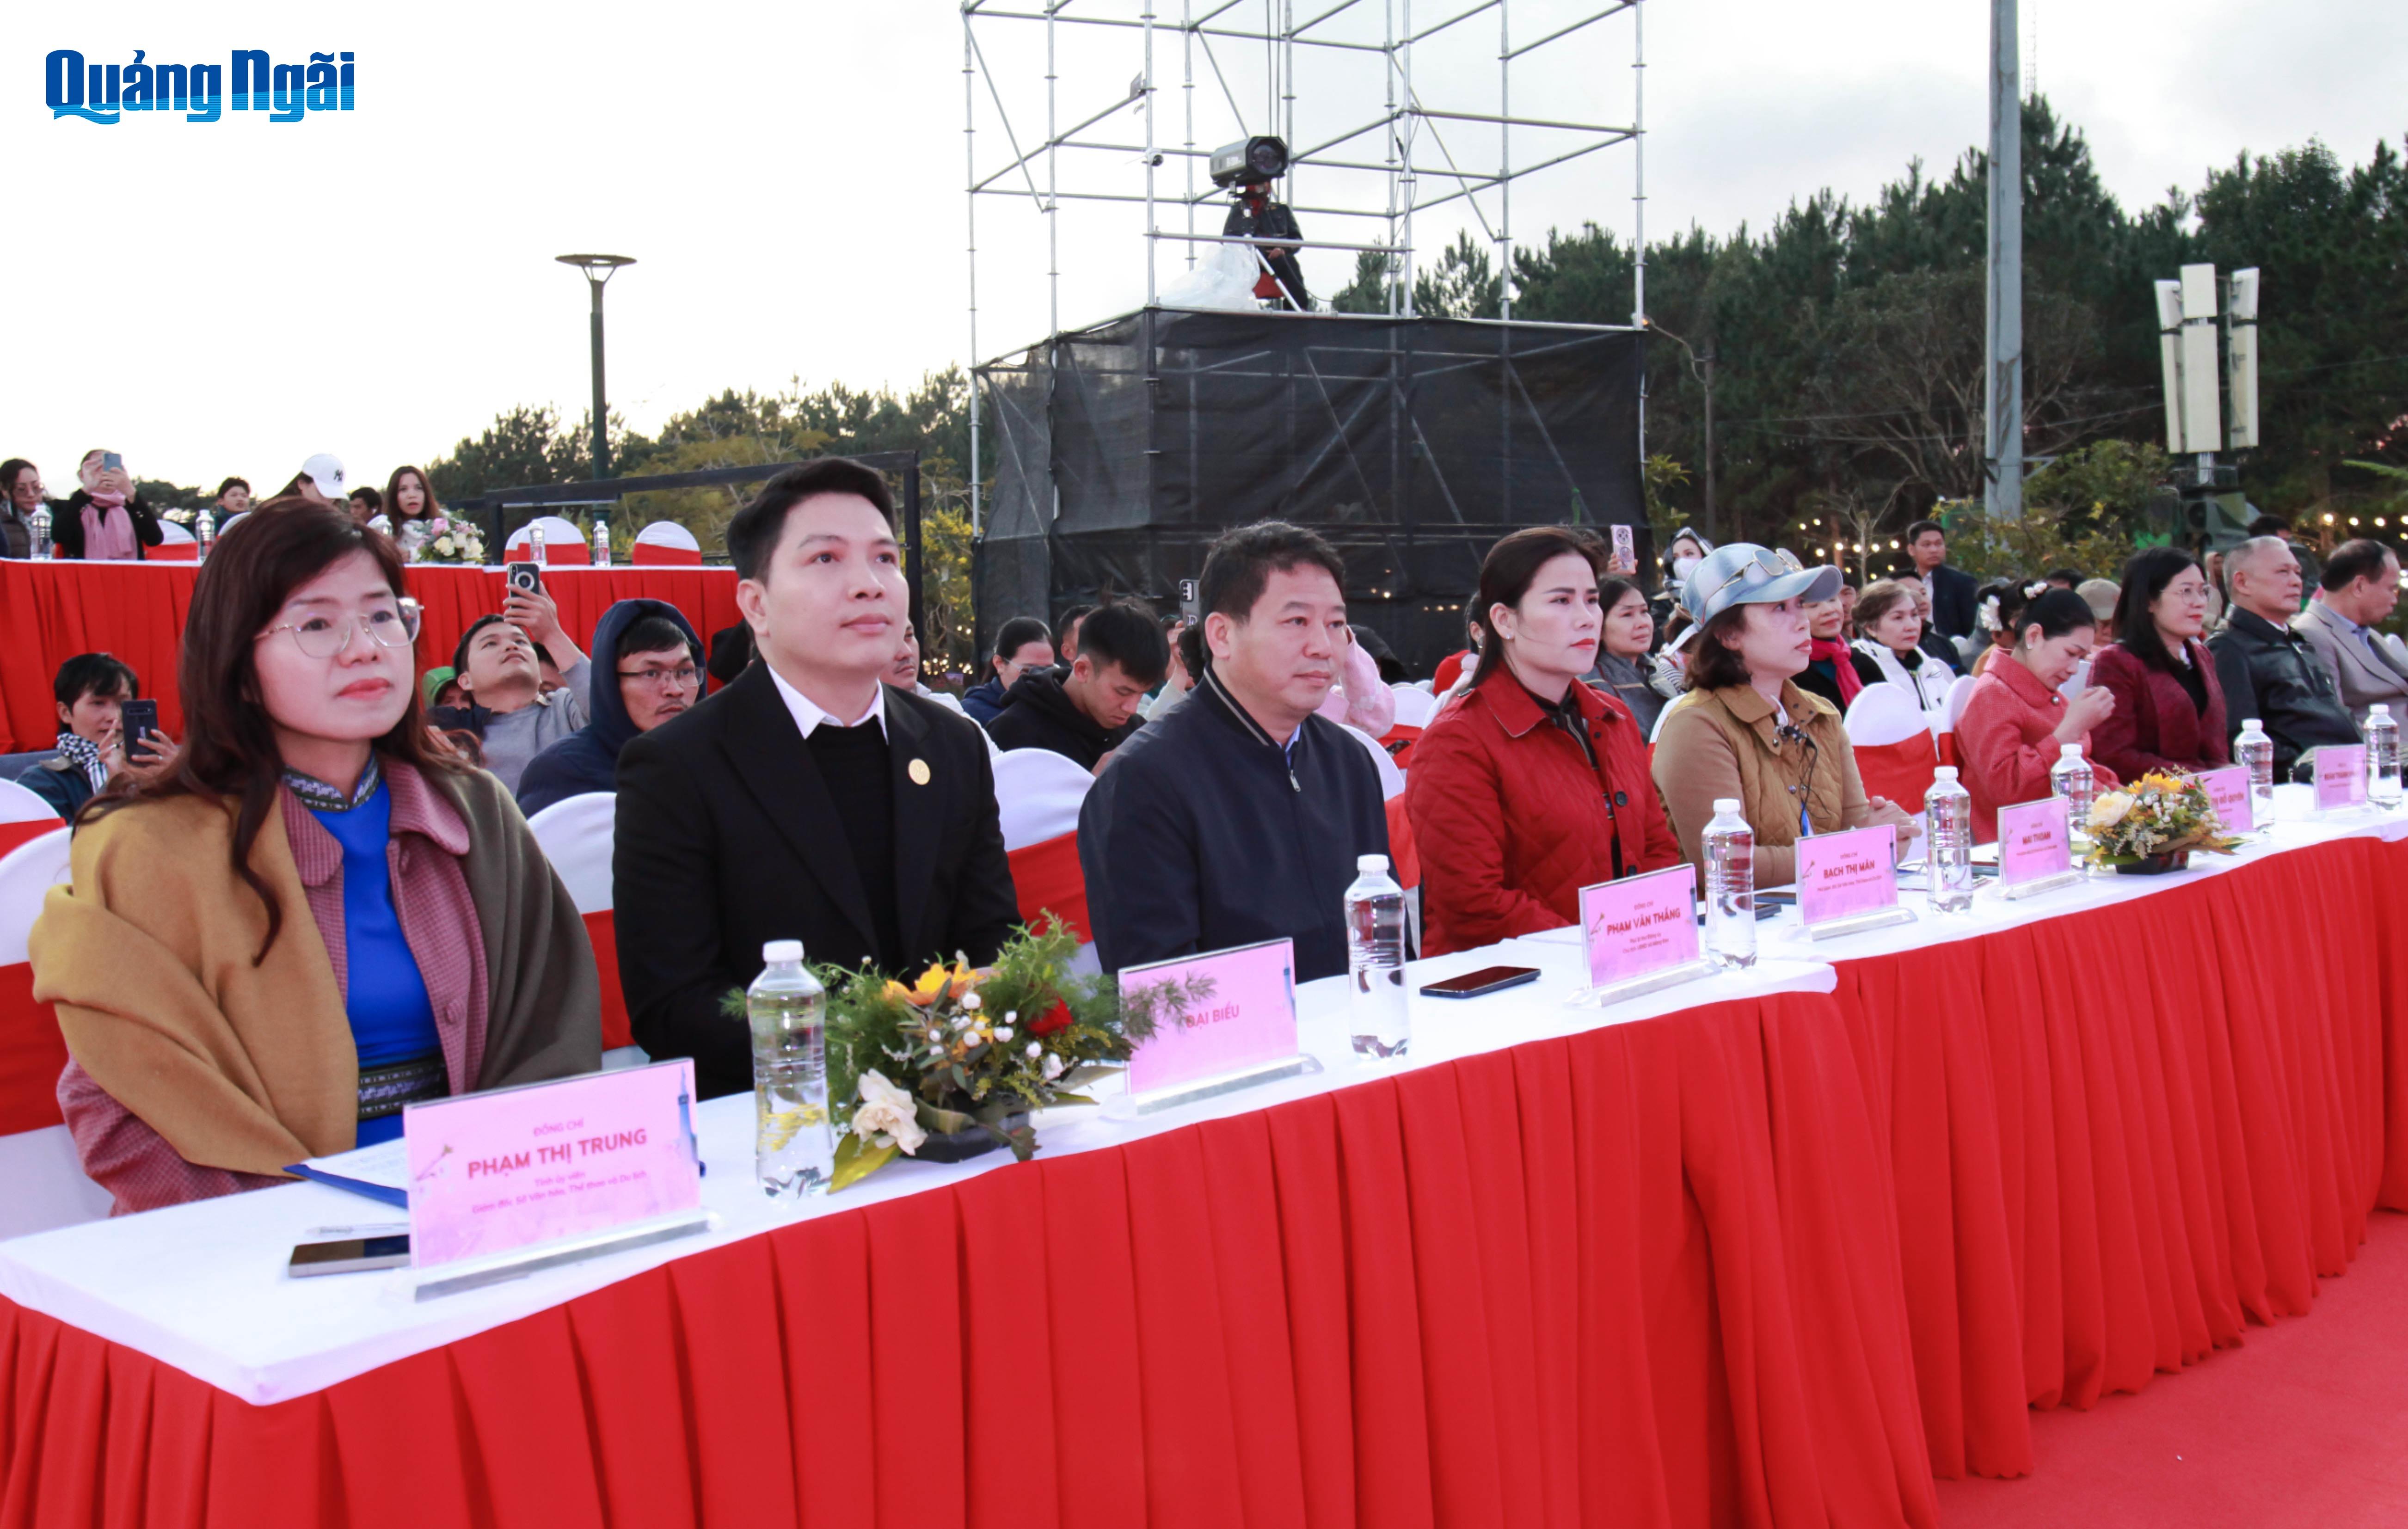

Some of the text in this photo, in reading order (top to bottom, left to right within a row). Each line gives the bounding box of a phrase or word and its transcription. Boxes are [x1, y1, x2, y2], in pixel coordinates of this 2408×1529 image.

[1824, 865, 1843, 880] BẠCH
[1845, 863, 1857, 875] THỊ
[1607, 906, 1680, 936] PHẠM VĂN THẮNG
[533, 1117, 584, 1137] ĐỒNG CHÍ
[468, 1128, 647, 1179] PHẠM THỊ TRUNG
